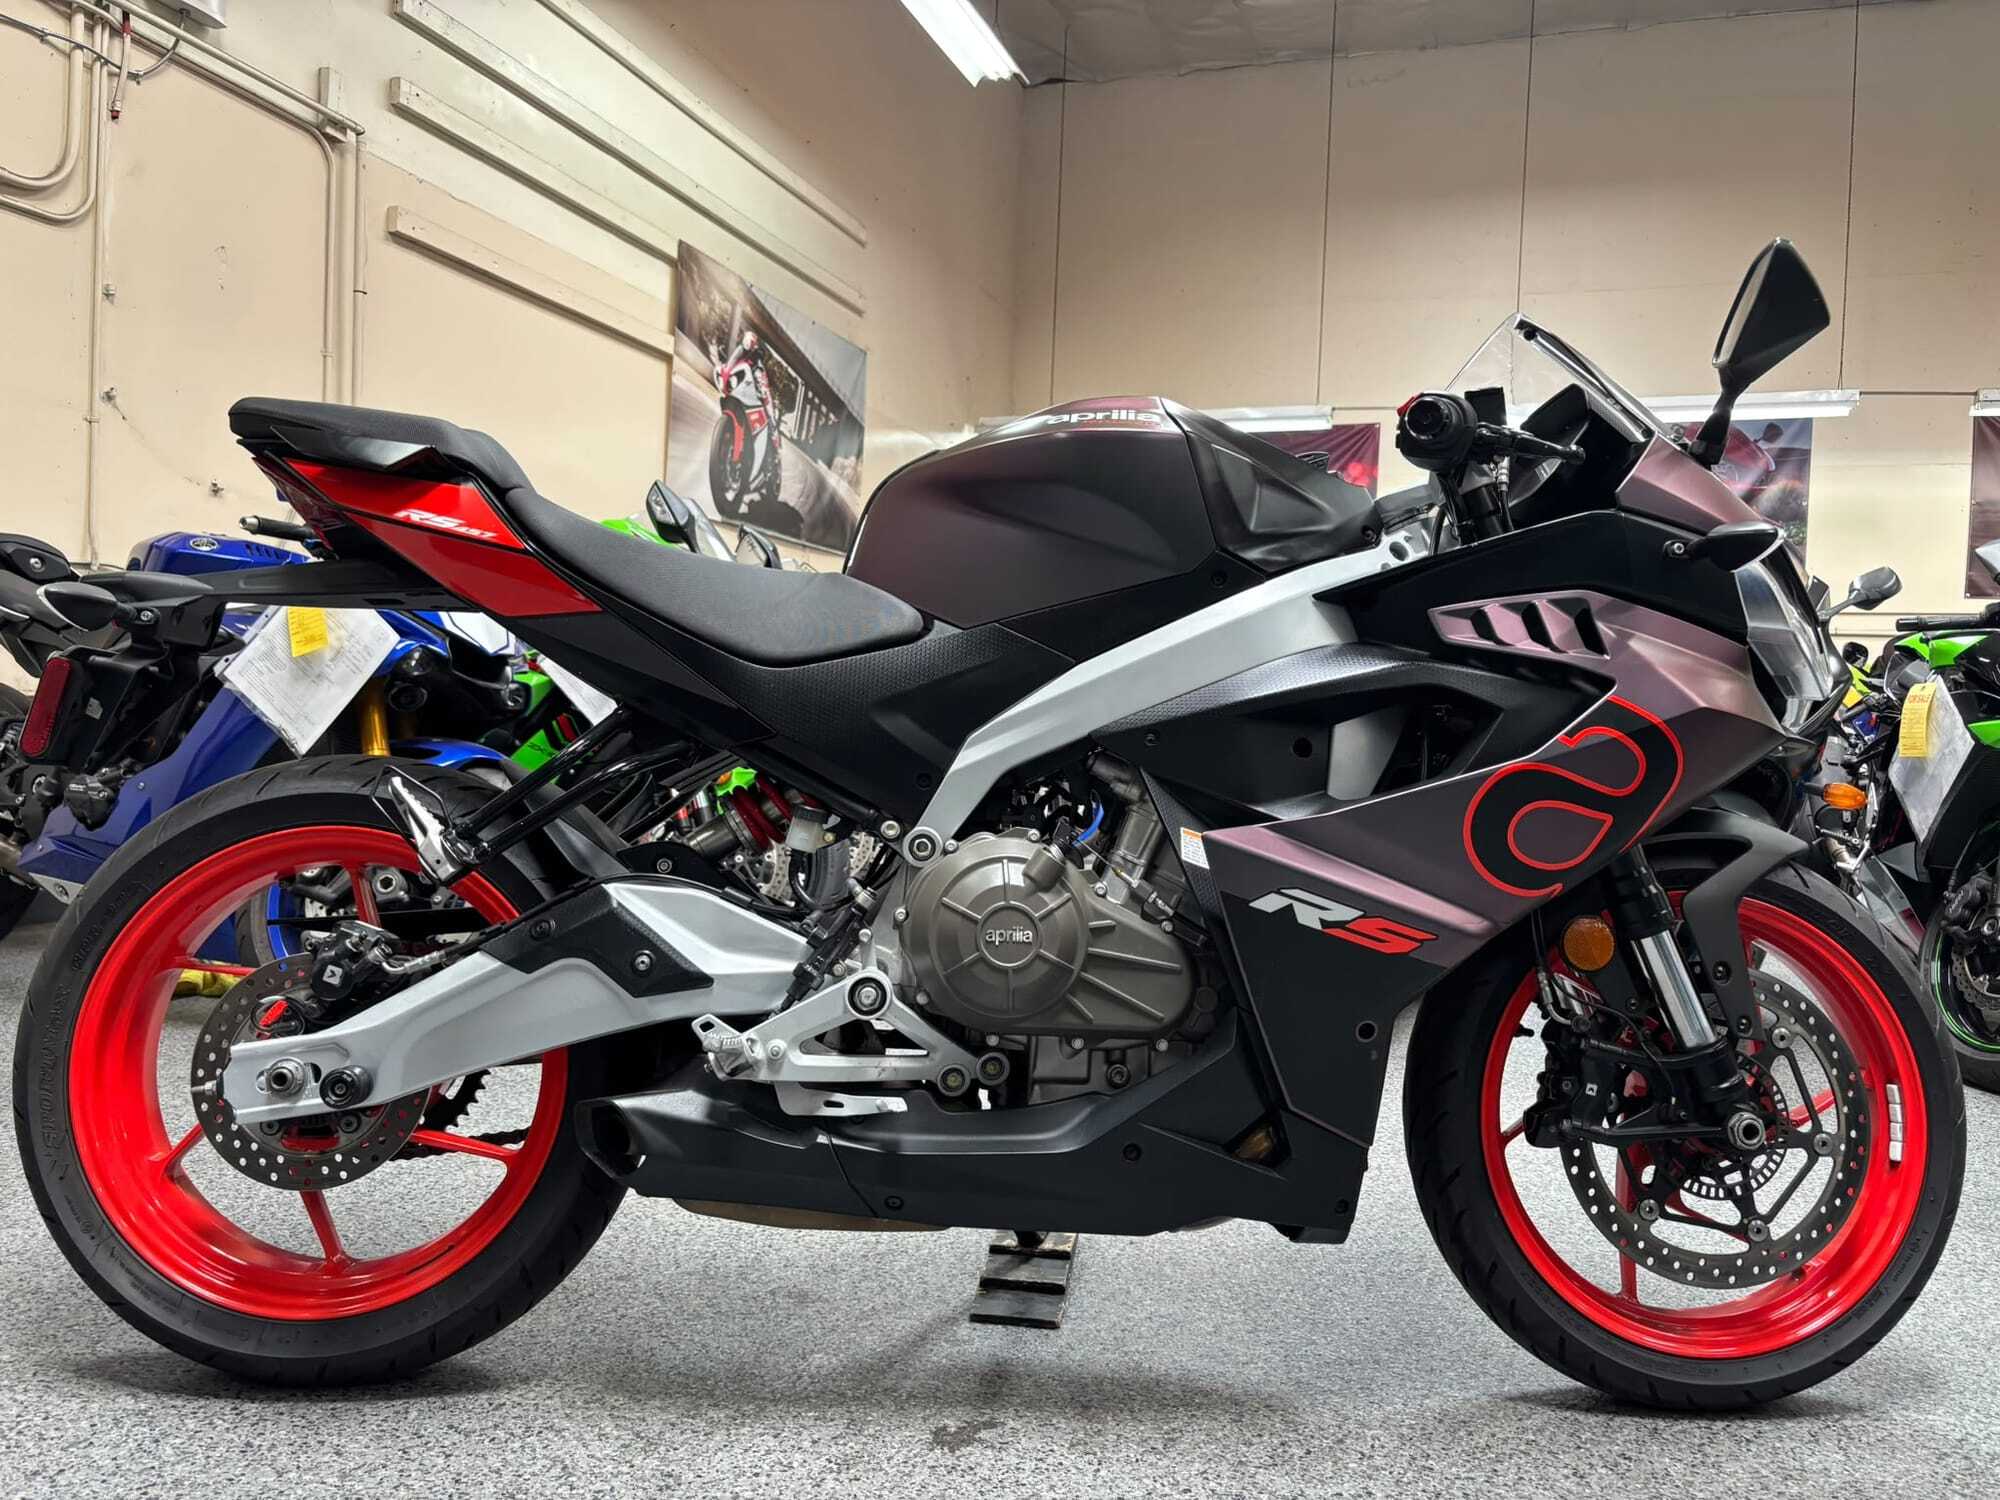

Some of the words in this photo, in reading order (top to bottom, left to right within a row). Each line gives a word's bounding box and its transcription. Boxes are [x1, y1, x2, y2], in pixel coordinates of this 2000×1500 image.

[1046, 409, 1161, 425] aprilia
[1248, 887, 1438, 954] RS
[985, 926, 1033, 946] aprilia
